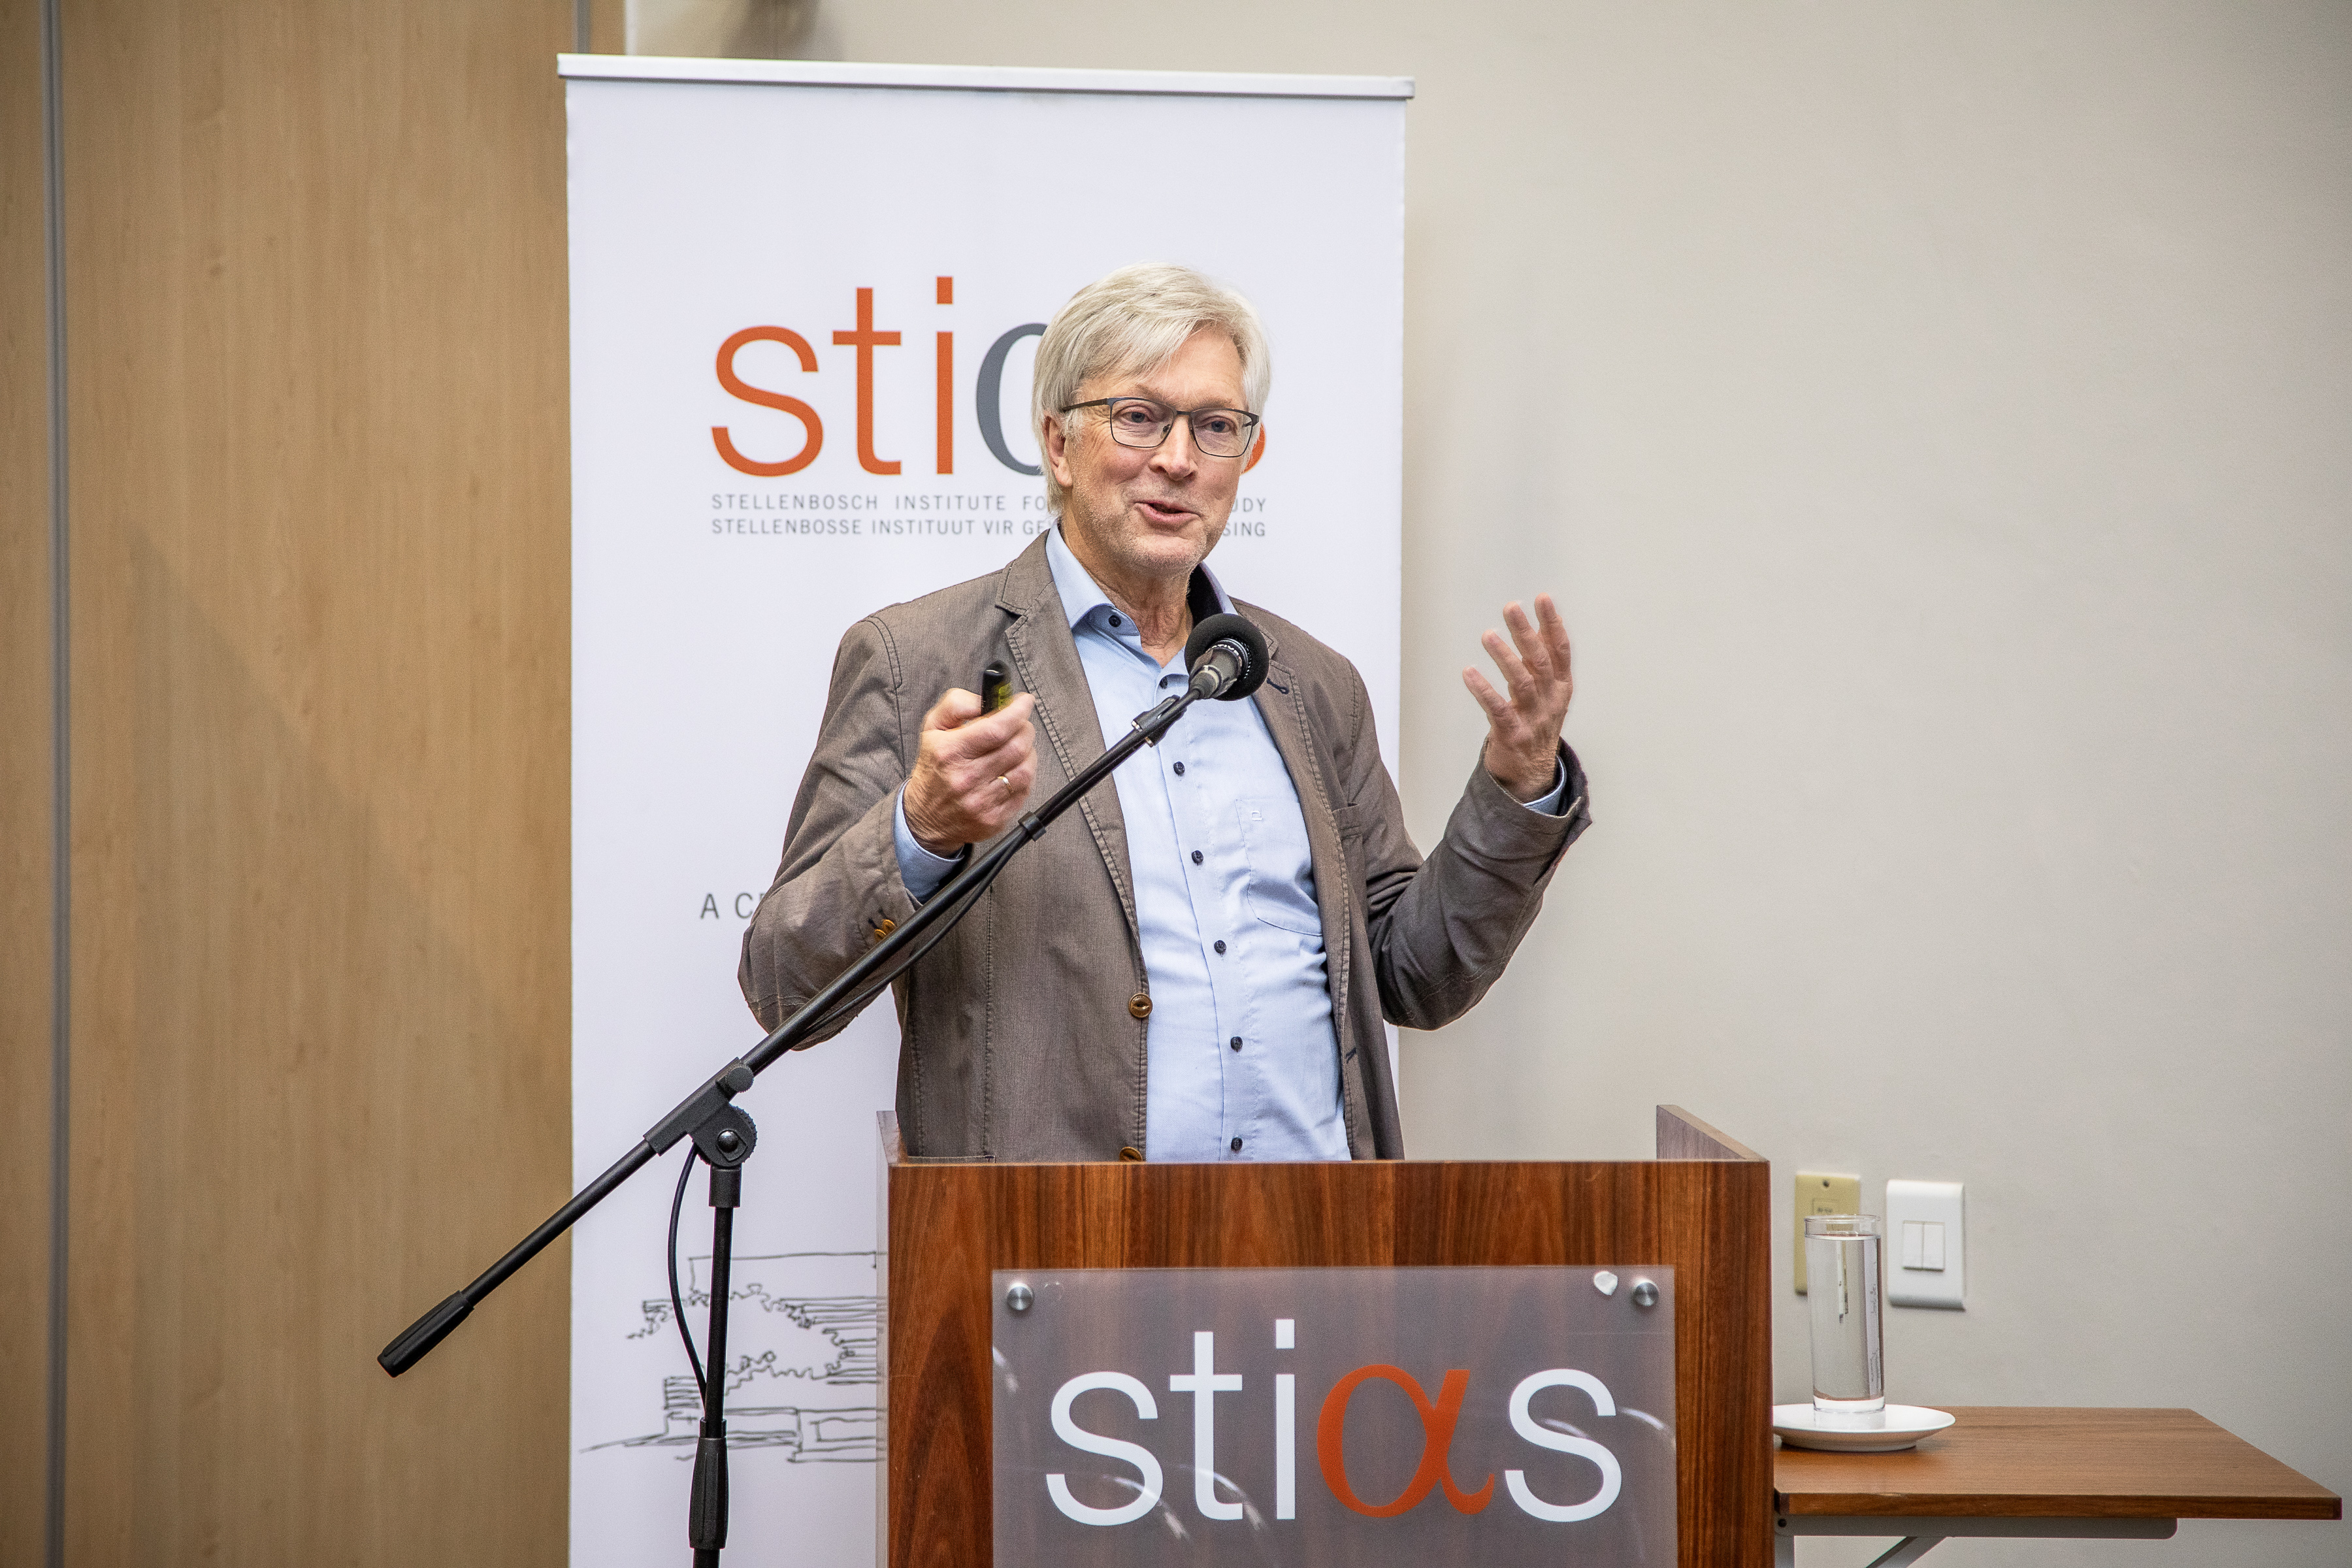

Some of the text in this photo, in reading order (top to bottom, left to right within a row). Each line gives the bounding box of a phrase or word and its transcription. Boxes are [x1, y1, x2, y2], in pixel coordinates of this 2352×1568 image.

[711, 276, 1266, 478] sti
[712, 494, 878, 511] STELLENBOSCH
[896, 495, 1006, 511] INSTITUTE
[1023, 495, 1047, 511] FO
[712, 519, 1266, 537] STELLENBOSSE INSTITUUT VIR GE SING
[700, 892, 766, 920] A C
